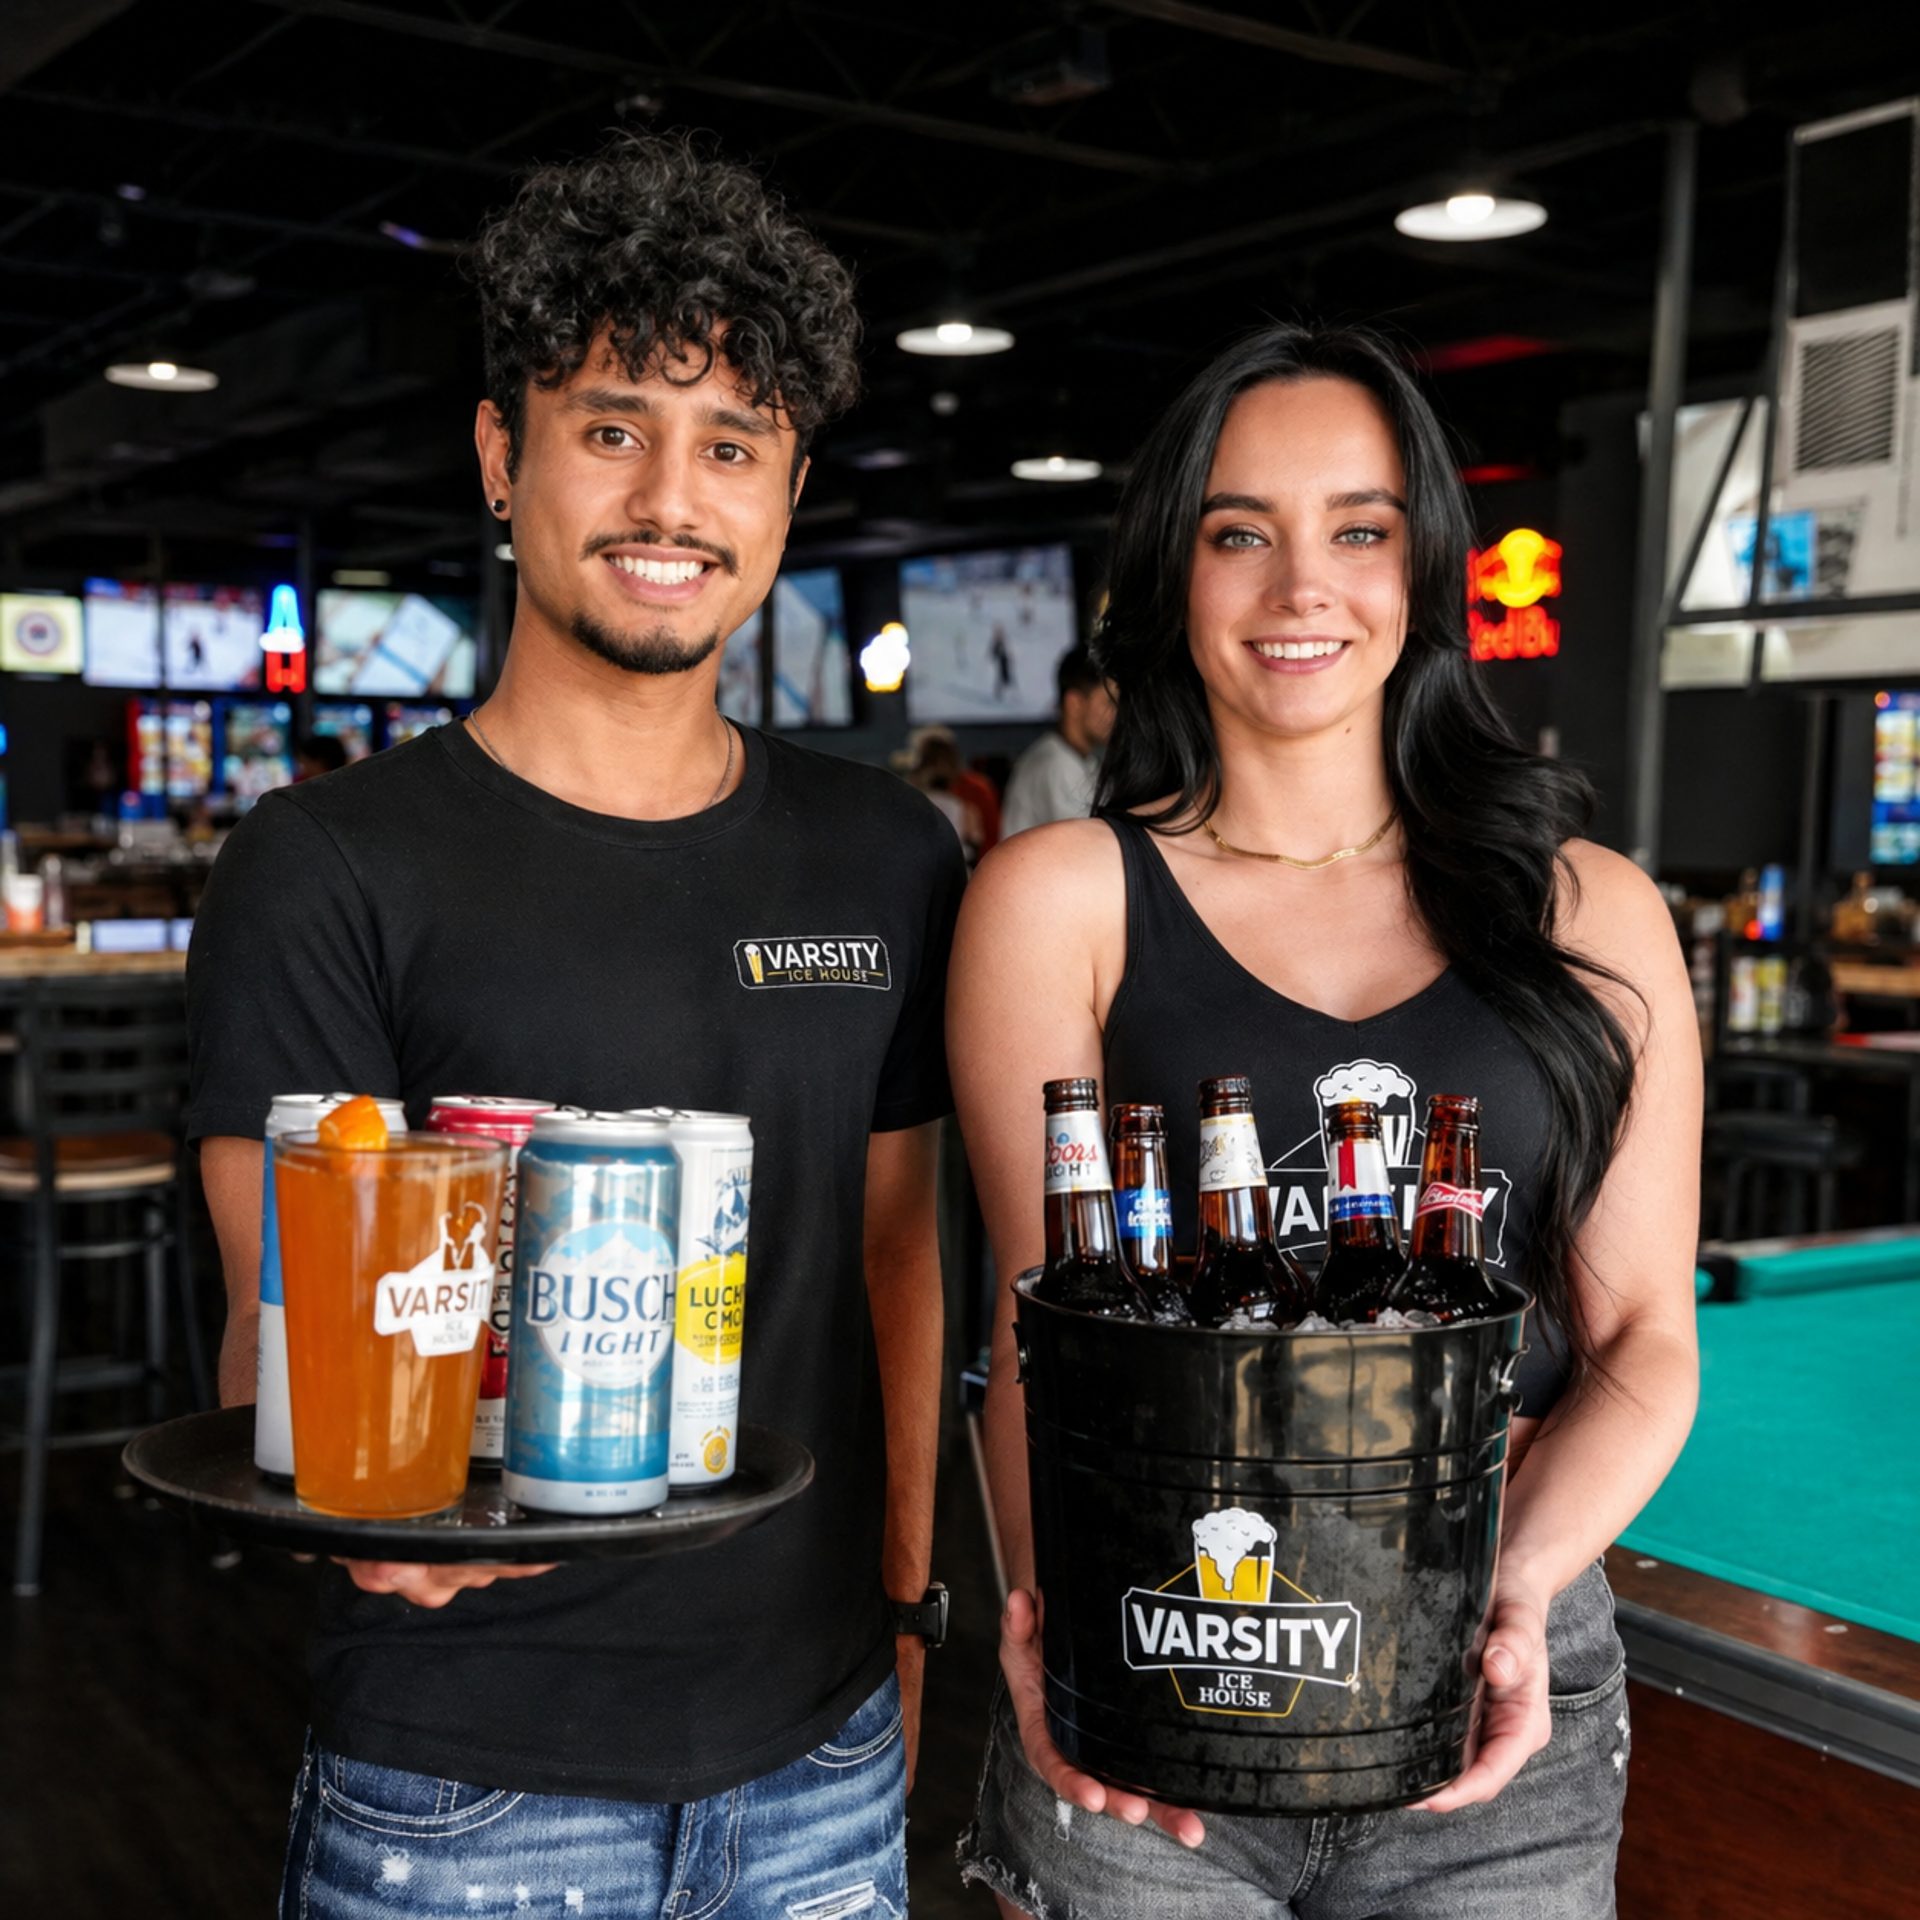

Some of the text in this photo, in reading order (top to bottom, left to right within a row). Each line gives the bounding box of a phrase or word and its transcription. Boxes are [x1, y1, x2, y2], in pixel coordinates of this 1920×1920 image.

[763, 942, 879, 970] VARSITY
[788, 968, 868, 982] ICE HOUSE
[388, 1280, 488, 1318] VARSIT
[530, 1269, 675, 1323] BUSCH
[690, 1284, 745, 1307] LUCH
[1131, 1603, 1351, 1670] VARSITY
[1217, 1672, 1253, 1691] ICE
[1199, 1686, 1272, 1708] HOUSE
